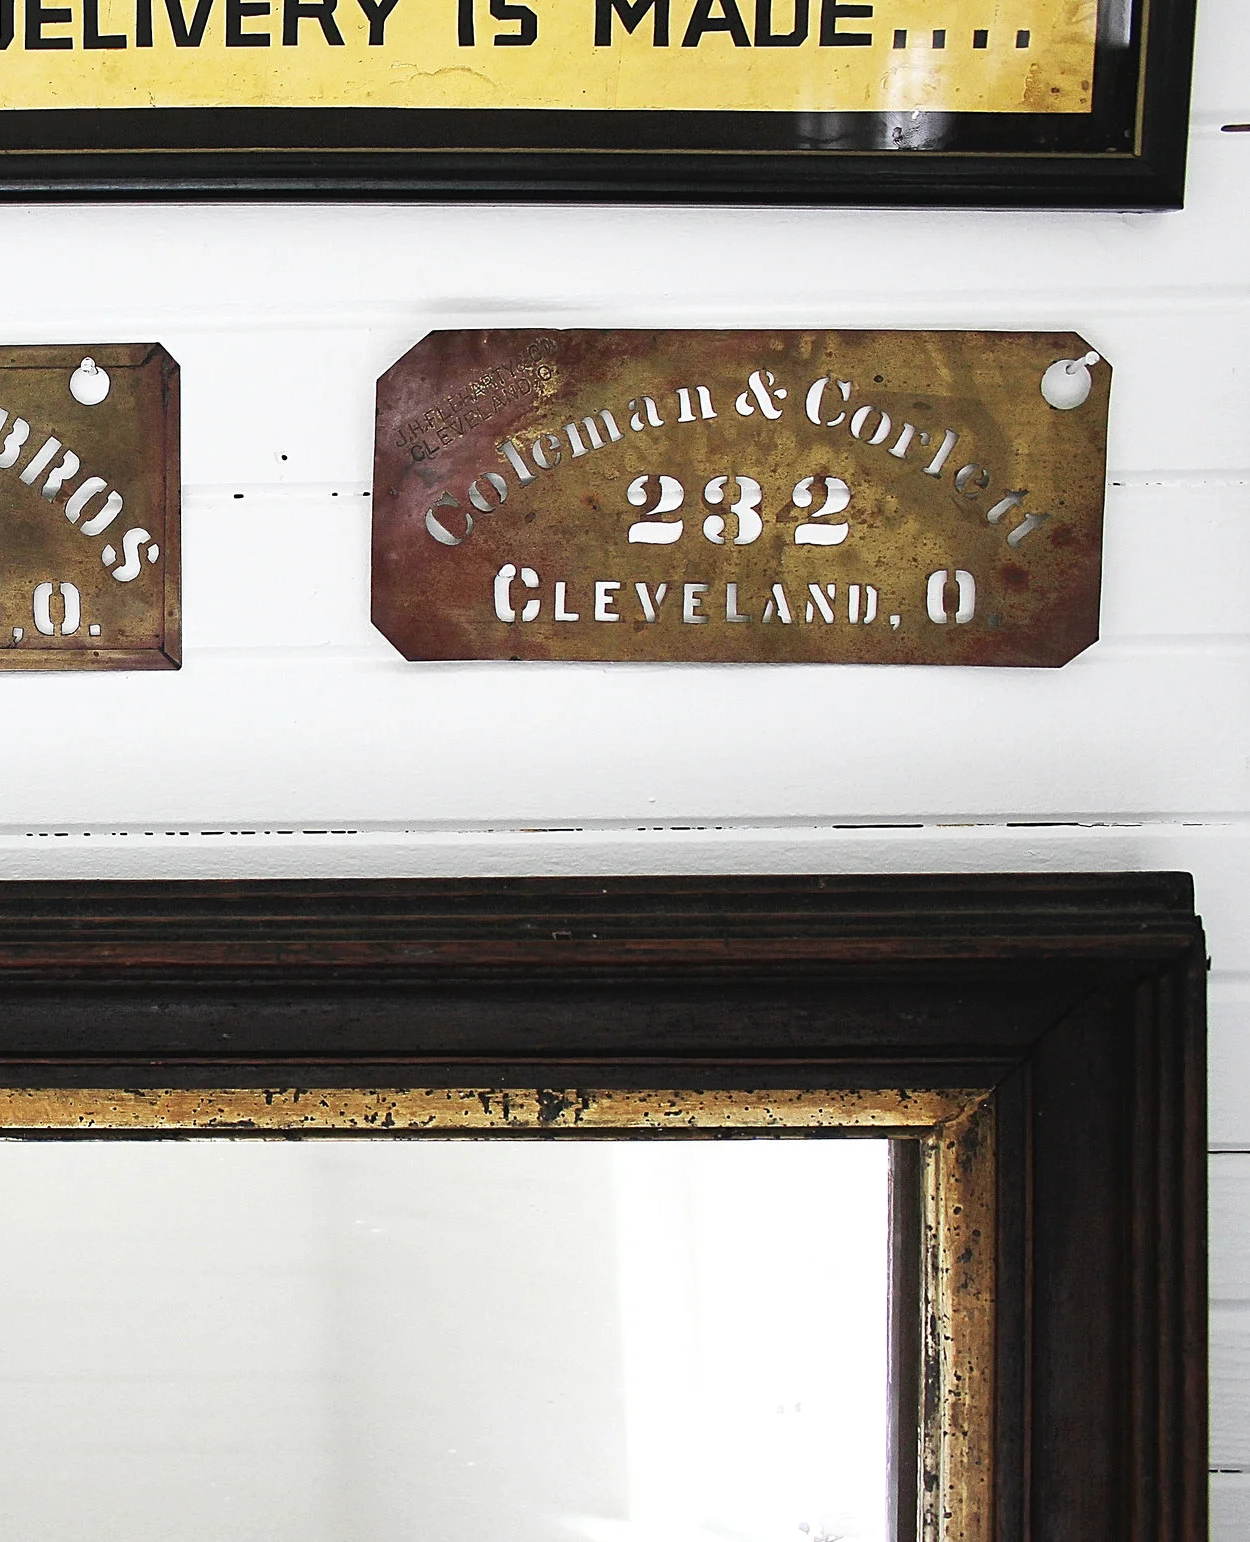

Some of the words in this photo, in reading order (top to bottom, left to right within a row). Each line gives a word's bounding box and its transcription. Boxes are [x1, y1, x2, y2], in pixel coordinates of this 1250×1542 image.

[456, 0, 539, 48] IS
[424, 384, 718, 547] Coleman
[735, 369, 788, 422] &
[805, 376, 1050, 548] Corlett
[626, 473, 851, 546] 232
